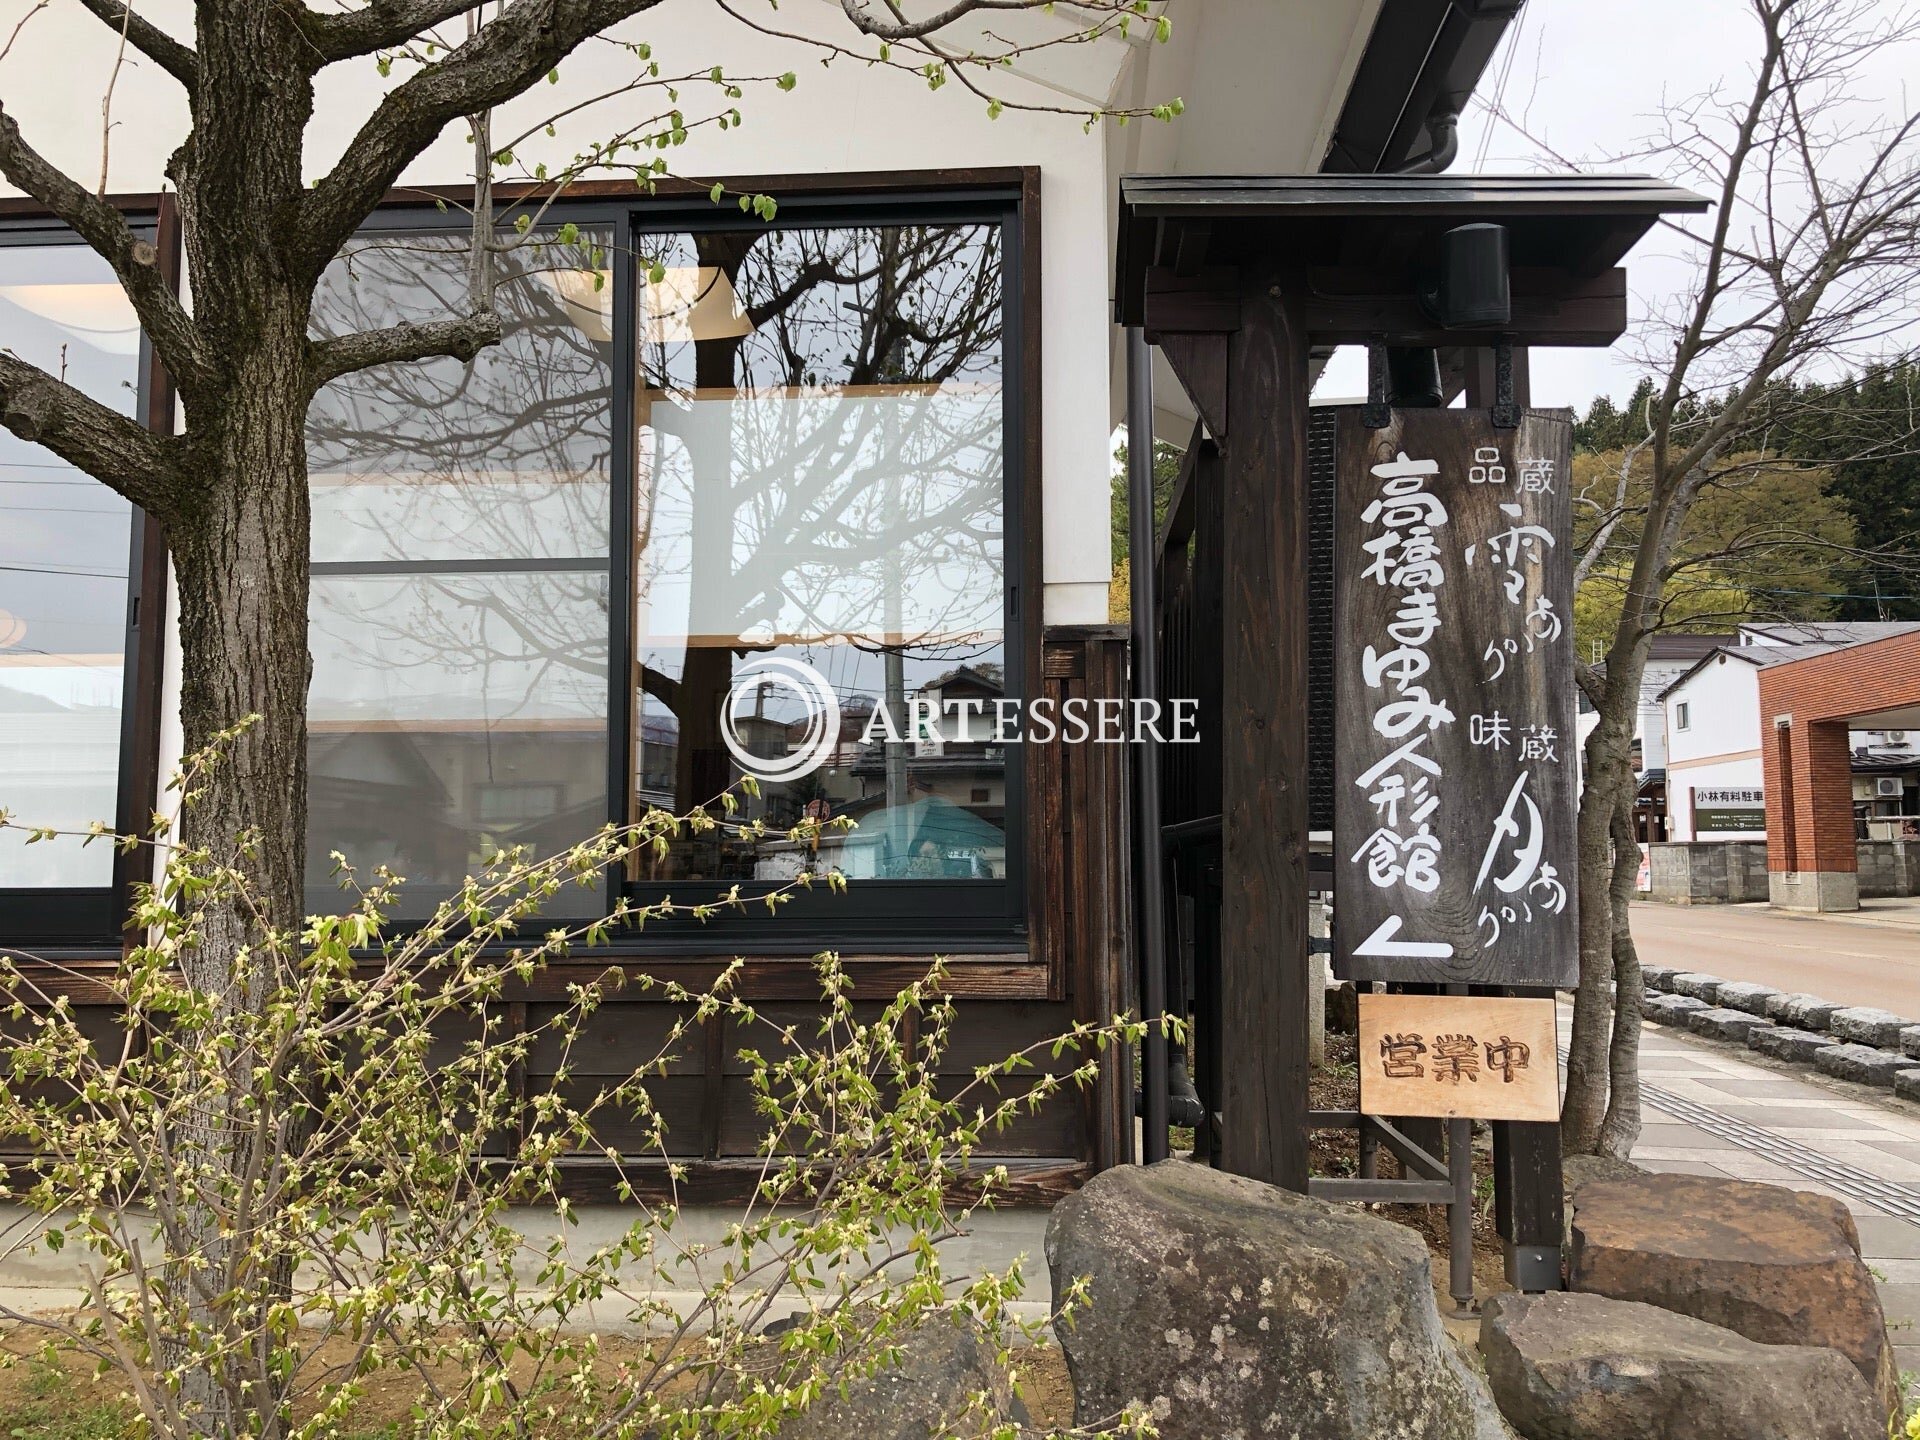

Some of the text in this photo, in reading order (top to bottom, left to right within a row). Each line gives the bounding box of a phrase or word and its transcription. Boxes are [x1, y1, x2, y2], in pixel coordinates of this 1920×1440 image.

[1351, 451, 1456, 893] 高橋まゆみ人形館
[1380, 1033, 1530, 1084] 営業中
